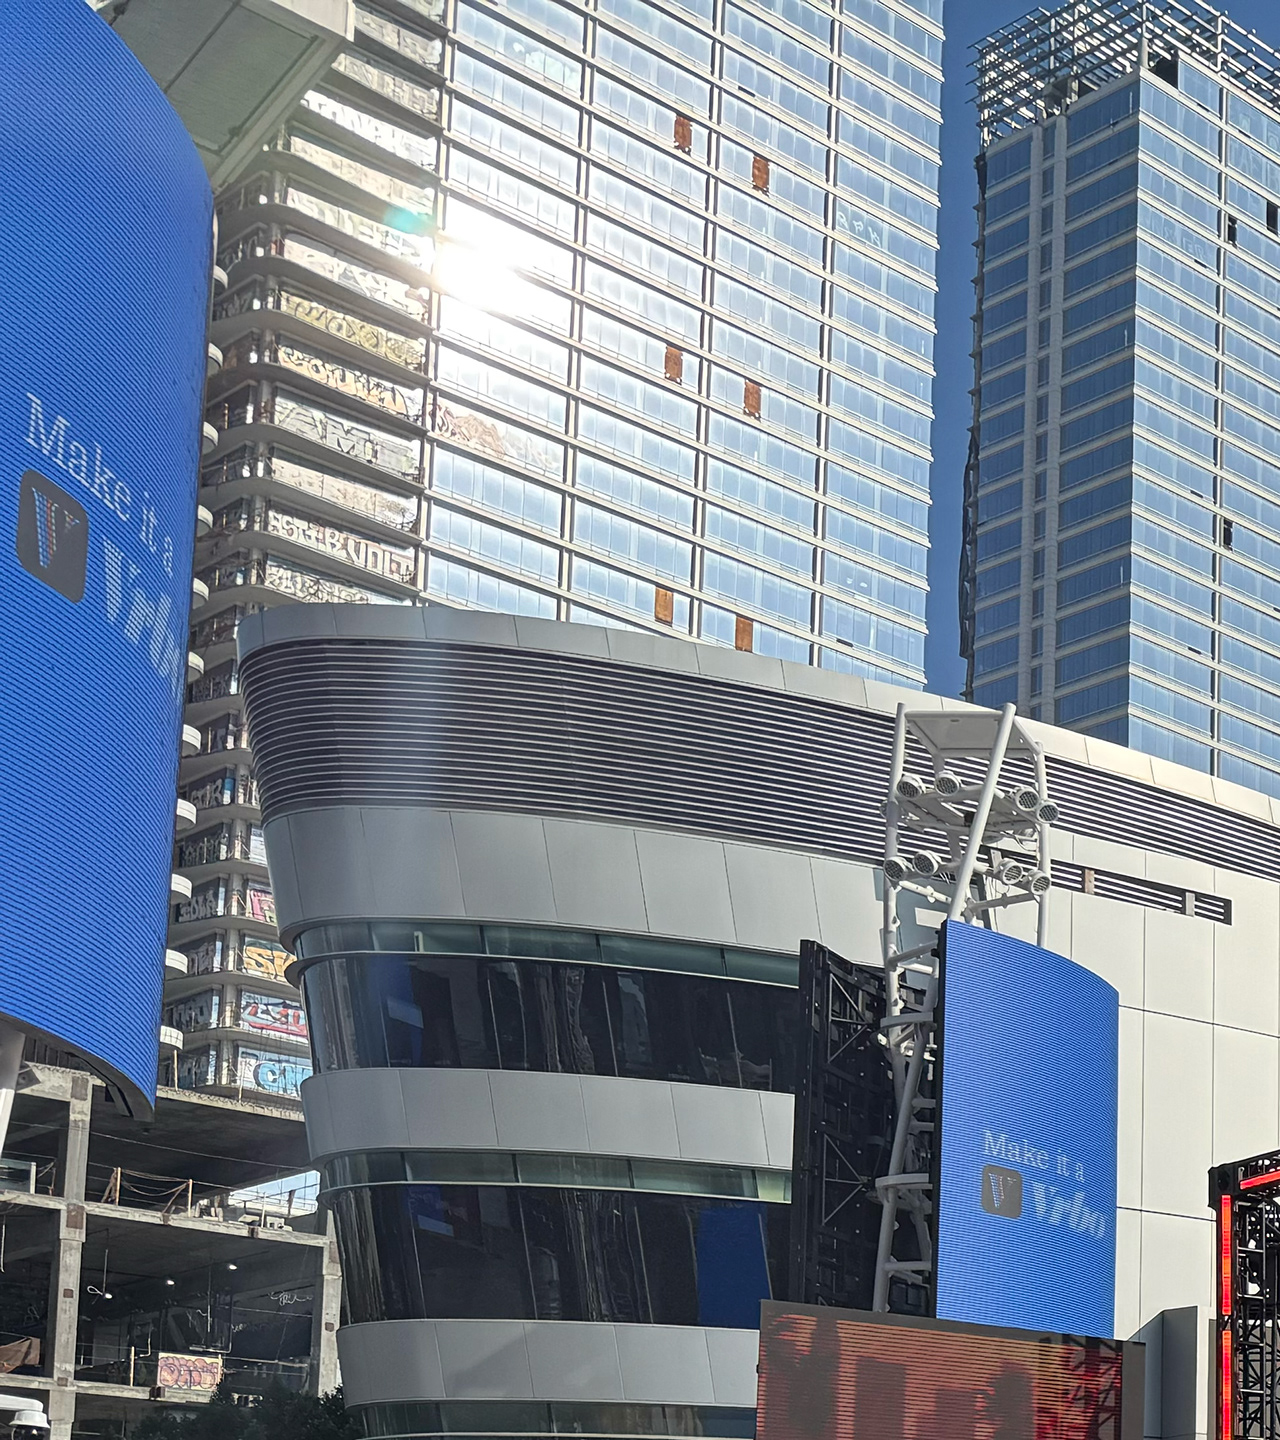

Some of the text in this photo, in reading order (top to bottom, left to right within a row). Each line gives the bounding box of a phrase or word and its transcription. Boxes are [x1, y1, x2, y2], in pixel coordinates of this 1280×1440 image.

[24, 392, 174, 580] Make it a
[983, 1129, 1085, 1183] Make it a
[1031, 1180, 1107, 1238] Vrbo
